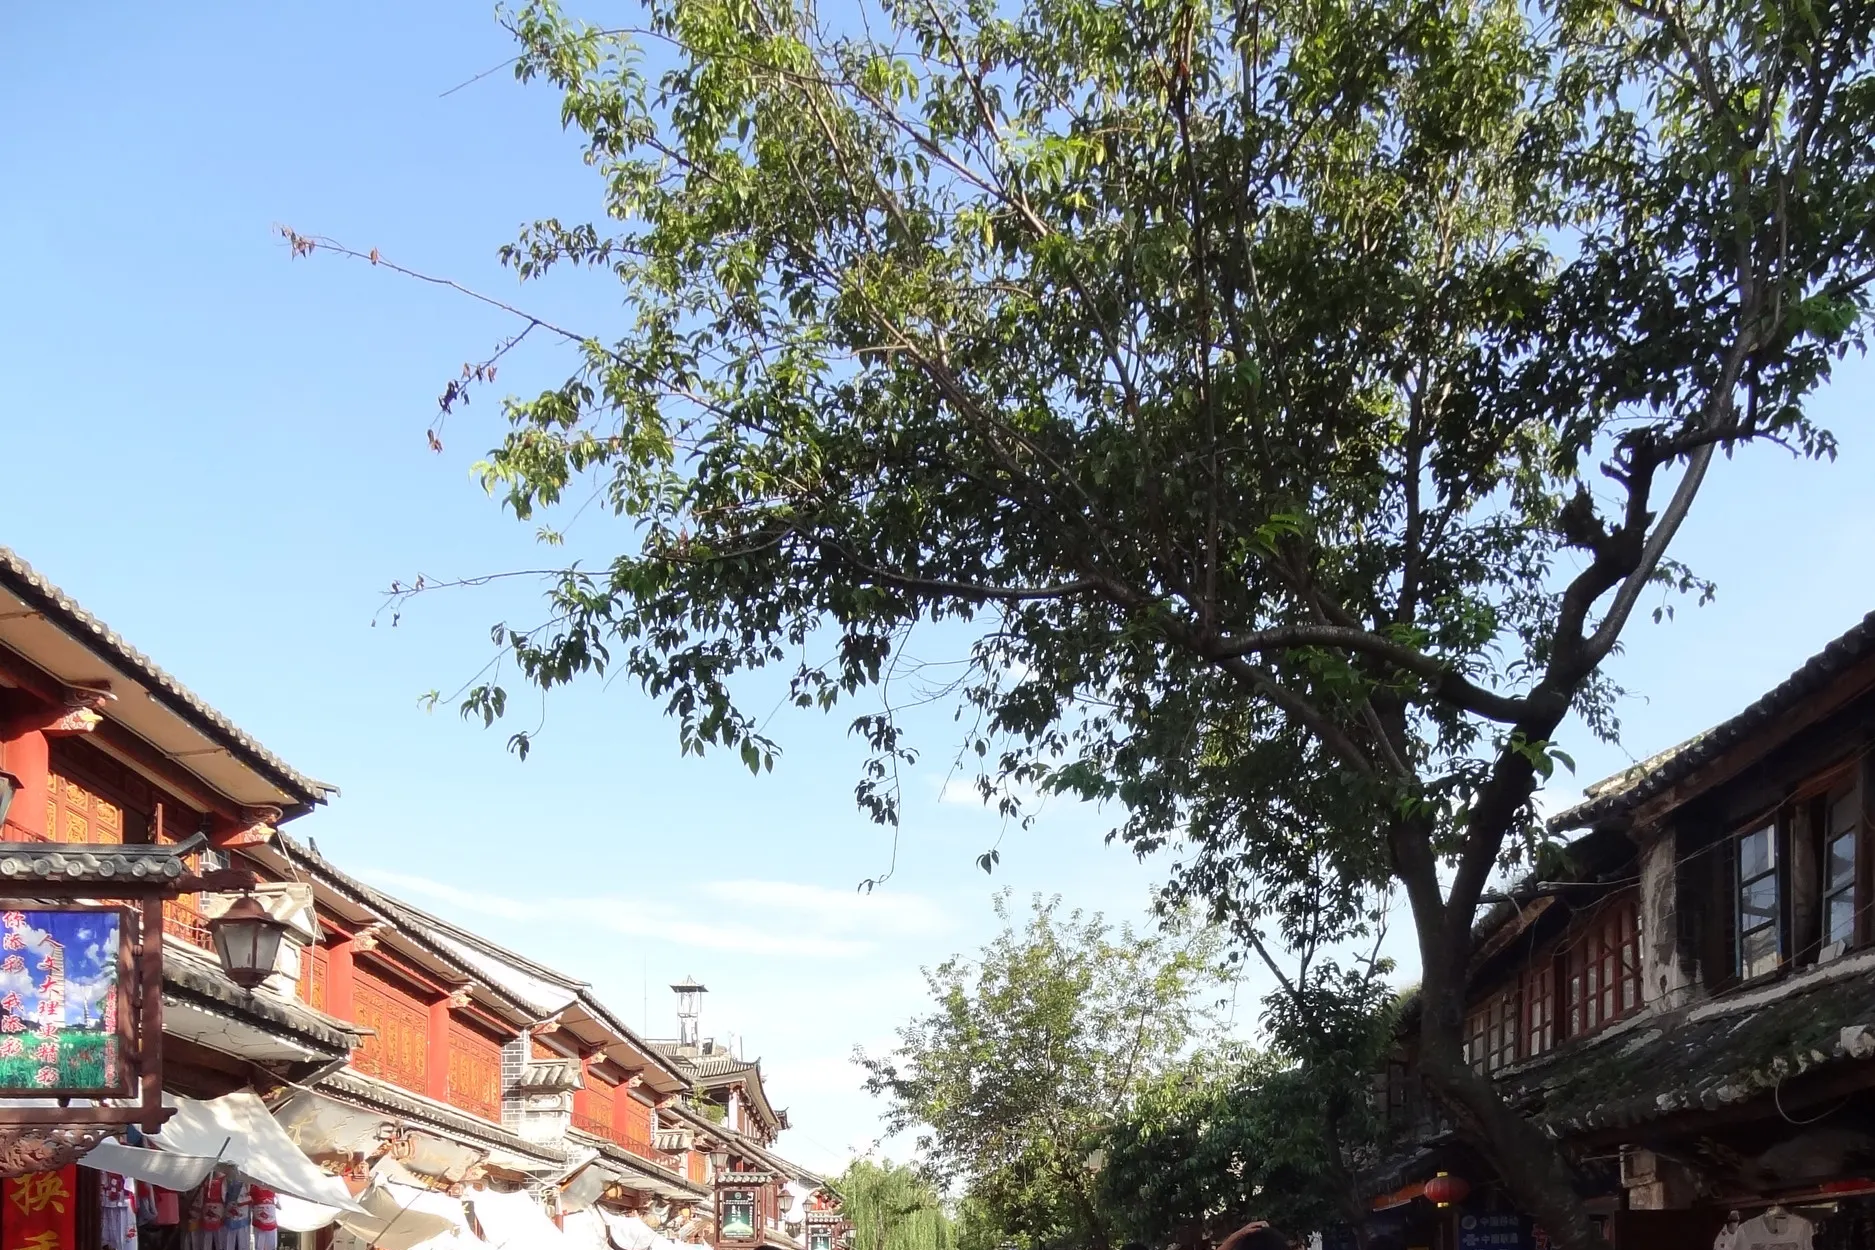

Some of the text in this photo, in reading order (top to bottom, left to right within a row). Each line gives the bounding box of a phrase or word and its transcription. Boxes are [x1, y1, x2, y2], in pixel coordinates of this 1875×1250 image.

[34, 933, 65, 1086] 人文大理更精彩
[1480, 1216, 1519, 1227] 中国移动
[1481, 1233, 1519, 1244] 中国联通
